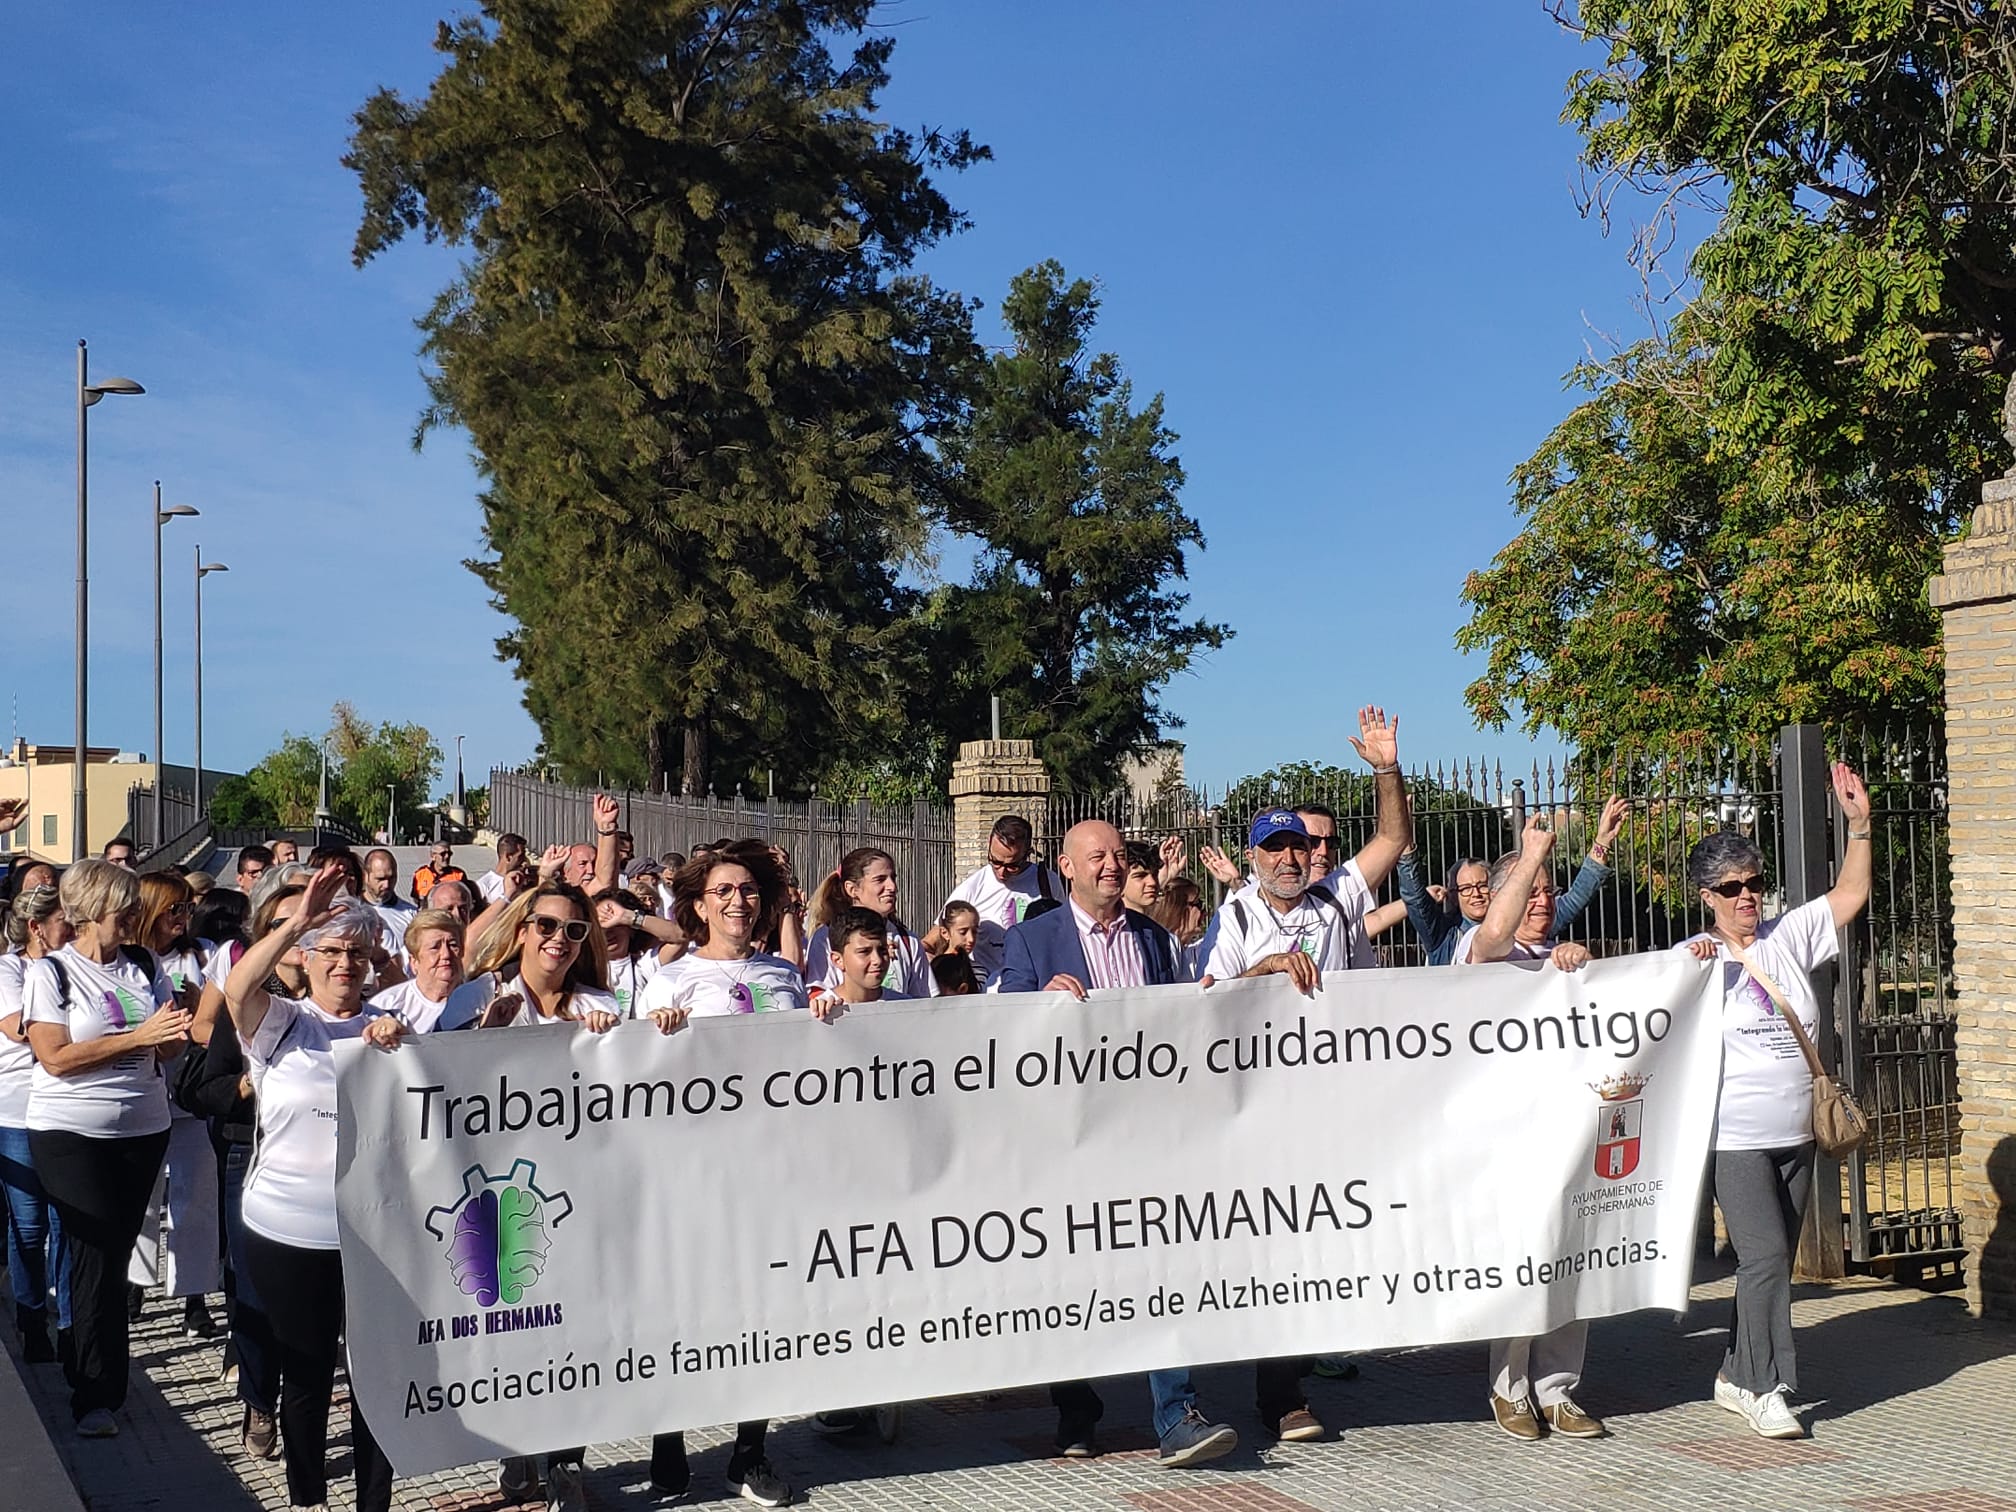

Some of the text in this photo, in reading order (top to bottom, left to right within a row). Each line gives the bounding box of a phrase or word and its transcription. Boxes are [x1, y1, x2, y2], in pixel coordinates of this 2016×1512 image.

[406, 1001, 1674, 1141] Trabajamos contra el olvido, cuidamos contigo
[1571, 1180, 1664, 1206] AYUNTAMIENTO DE
[1577, 1195, 1656, 1218] DOS HERMANAS
[805, 1221, 915, 1284] AFA
[931, 1206, 1048, 1269] DOS
[1065, 1178, 1373, 1255] HERMANAS
[404, 1237, 1668, 1419] Asociación de familiares de enfermos/as de Alzheimer y otras demencias.
[418, 1302, 563, 1345] AFA DOS HERMANAS
